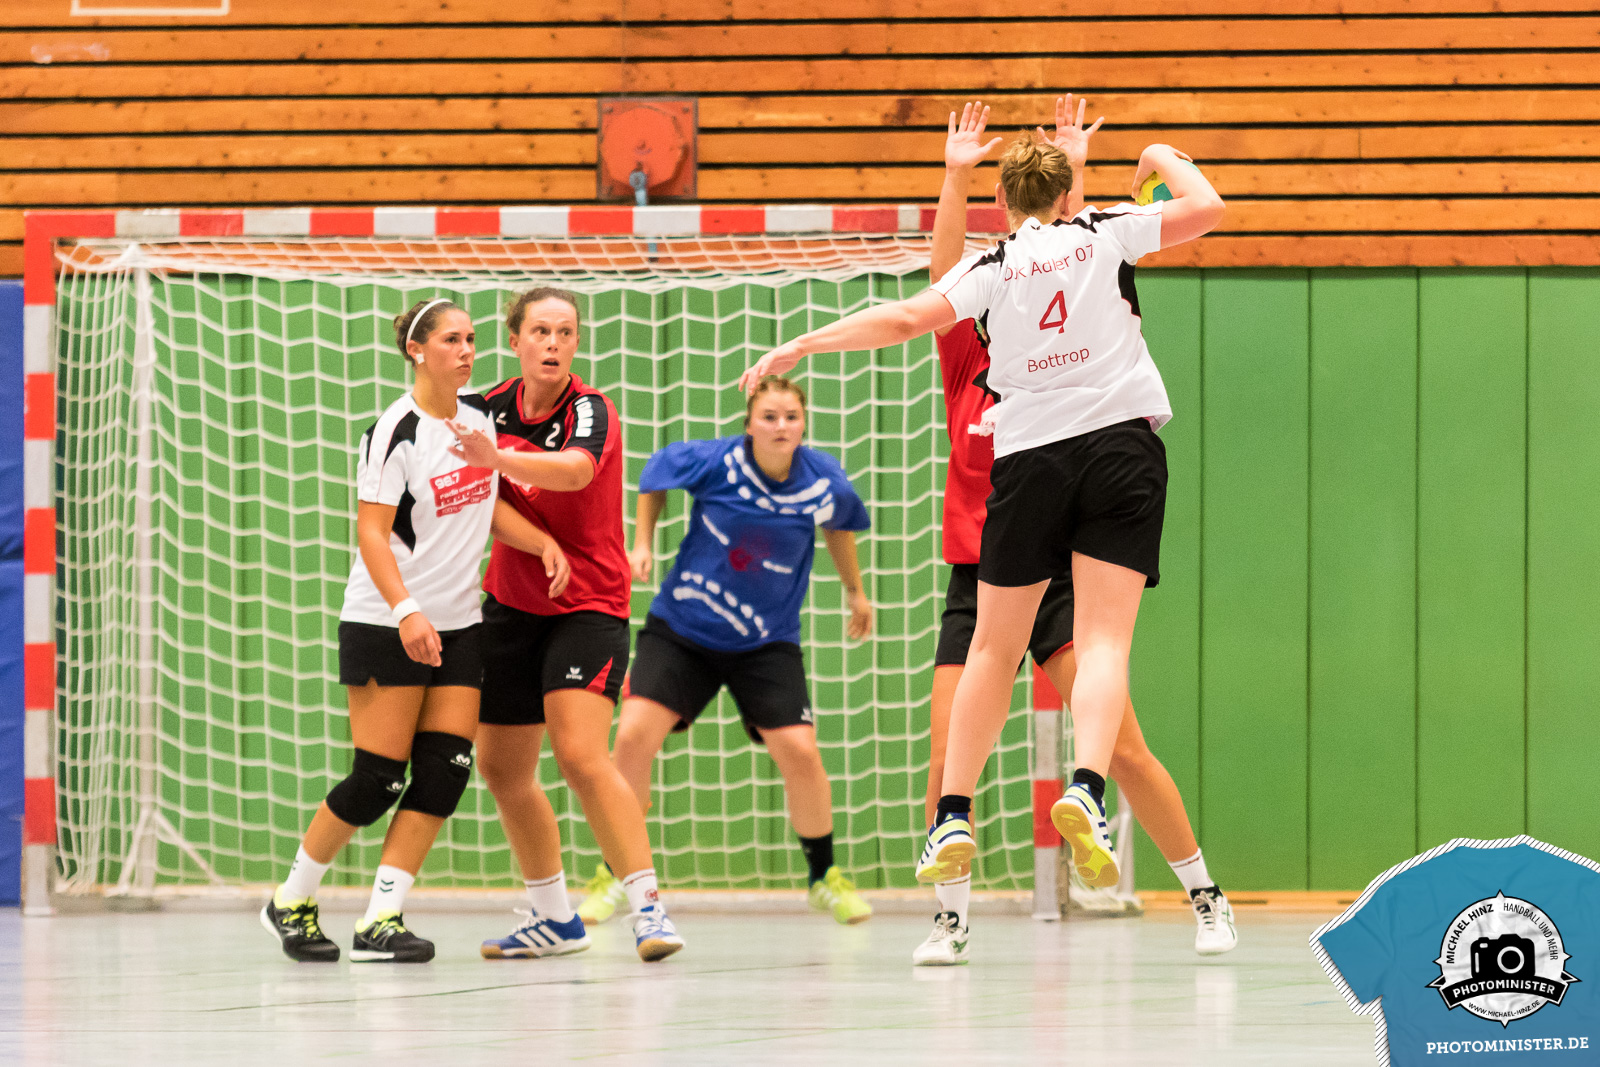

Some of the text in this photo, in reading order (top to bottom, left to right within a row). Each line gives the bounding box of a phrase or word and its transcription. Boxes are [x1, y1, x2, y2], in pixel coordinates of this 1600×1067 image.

[1031, 255, 1070, 276] Adler
[1075, 244, 1094, 262] 07
[1038, 290, 1068, 334] 4
[1027, 348, 1090, 373] Bottrop
[545, 422, 561, 448] 2
